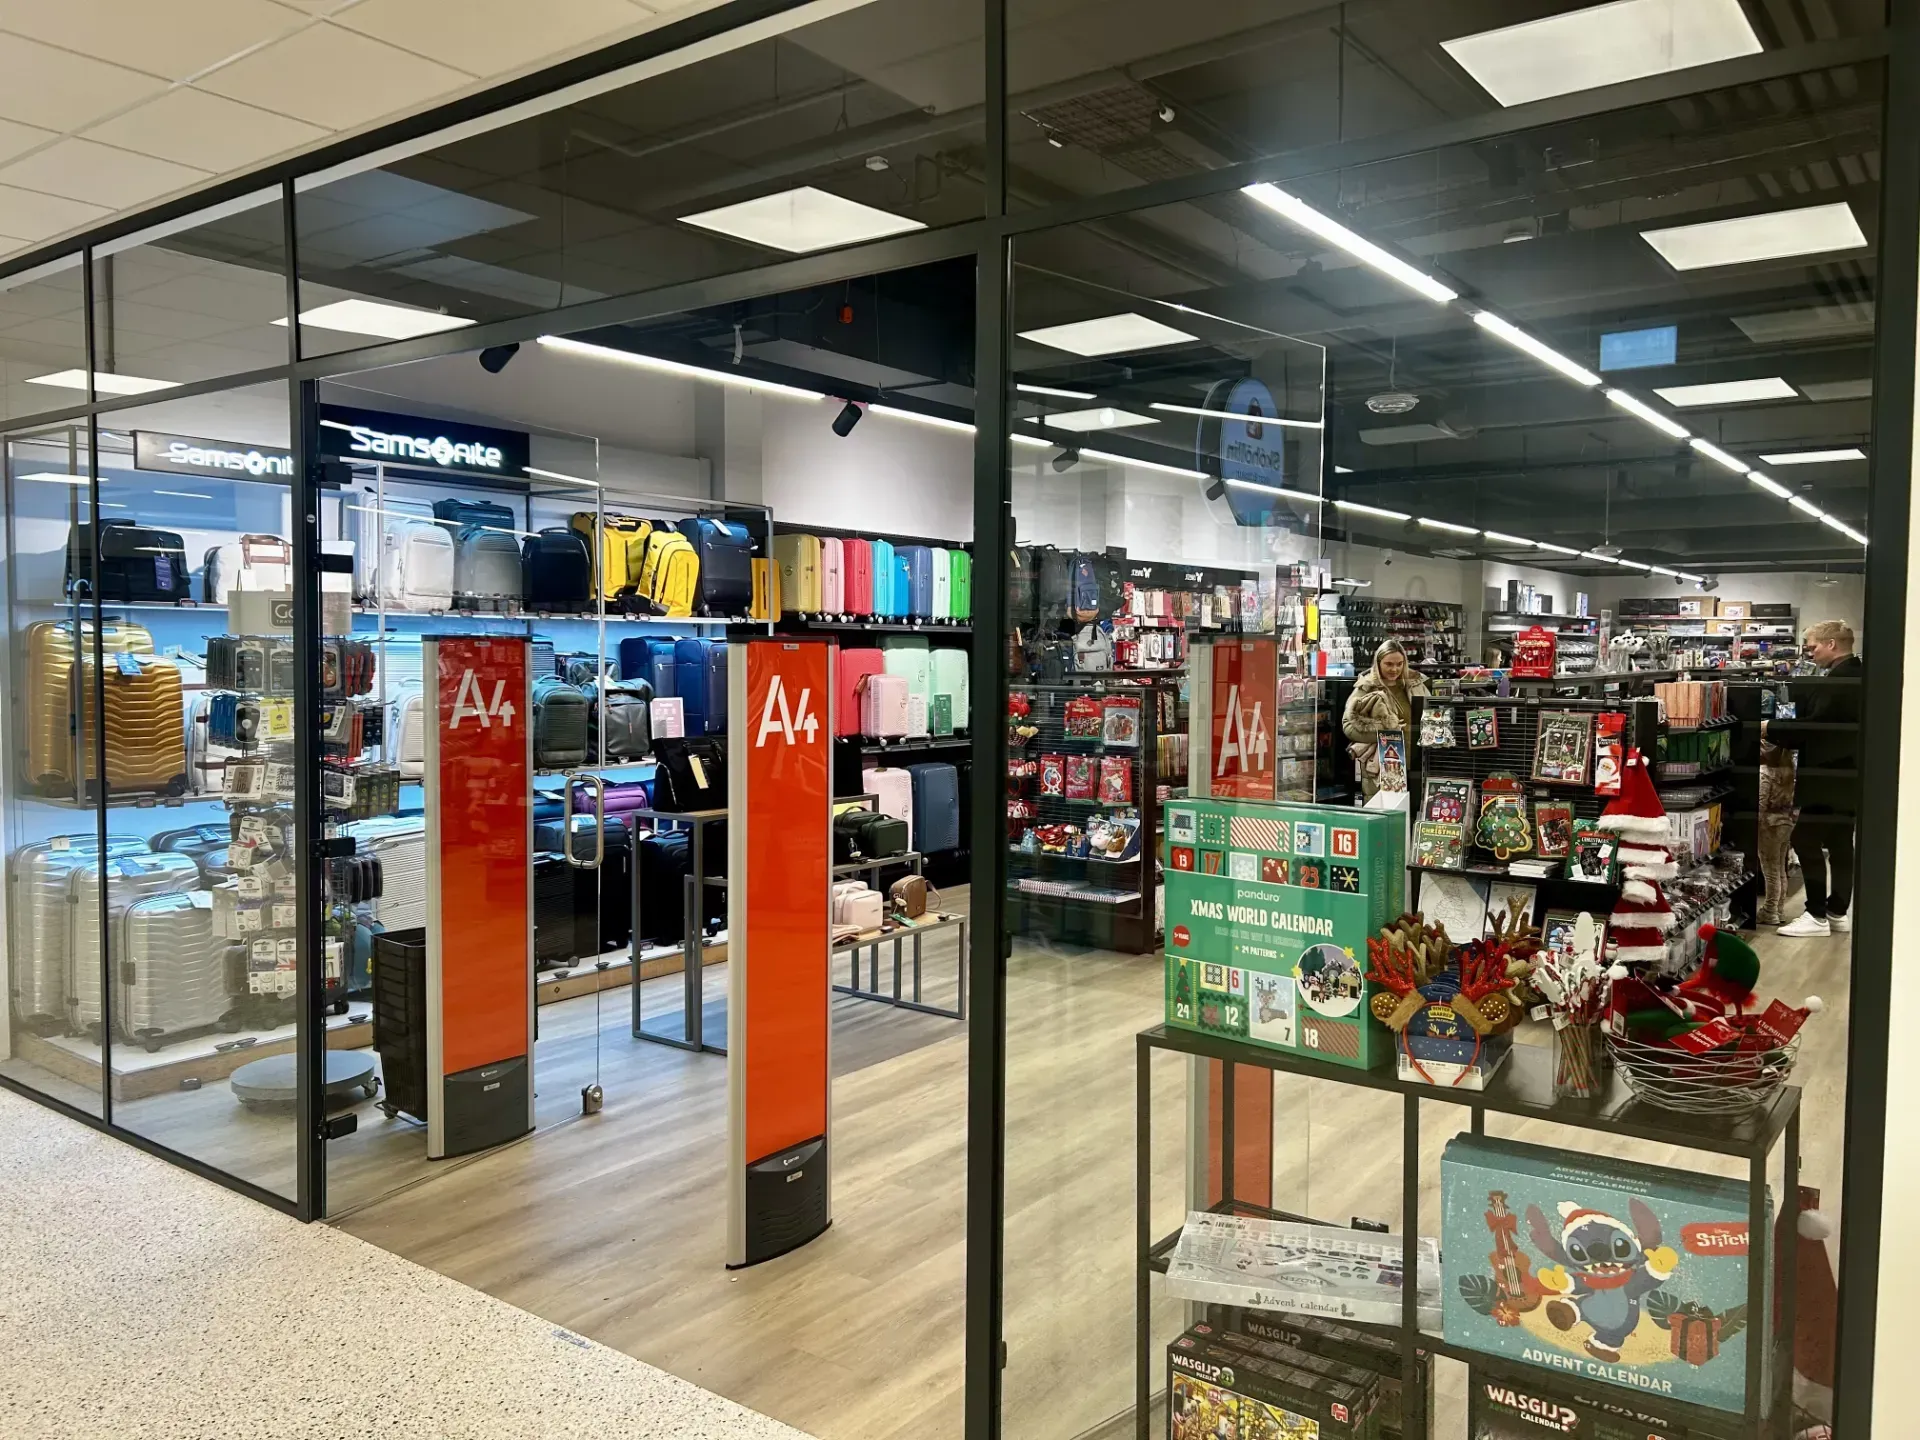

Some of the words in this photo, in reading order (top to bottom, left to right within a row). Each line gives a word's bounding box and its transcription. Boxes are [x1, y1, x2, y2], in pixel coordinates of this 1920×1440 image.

[350, 426, 501, 468] Samsonite
[168, 443, 294, 475] Samsonit
[449, 668, 516, 729] A4
[755, 675, 819, 747] A4
[1218, 684, 1268, 776] A4
[1209, 822, 1216, 836] 5
[1276, 830, 1286, 850] 8
[1338, 834, 1352, 853] 16
[1178, 854, 1188, 868] 13
[1204, 852, 1222, 875] 17
[1300, 865, 1319, 889] 23
[1237, 889, 1280, 903] panduro
[1190, 899, 1223, 920] XMAS
[1226, 904, 1267, 927] WORLD
[1271, 911, 1334, 938] CALENDAR
[1250, 946, 1277, 959] PATTERNS
[1232, 970, 1239, 988] 6
[1176, 1003, 1190, 1019] 24
[1225, 1006, 1239, 1026] 12
[1284, 1027, 1291, 1041] 7
[1304, 1028, 1318, 1048] 18
[1549, 1172, 1589, 1183] ADVENT
[1592, 1179, 1647, 1193] CALENDAR
[1555, 1166, 1594, 1177] ADVENT
[1596, 1172, 1652, 1187] CALENDAR
[1263, 1295, 1295, 1308] Advent
[1300, 1302, 1340, 1314] calendar
[1171, 1353, 1221, 1382] WASGIJ?
[1521, 1347, 1583, 1375] ADVENT
[1587, 1362, 1673, 1394] CALENDAR
[1486, 1383, 1578, 1432] WASGIJ?
[1520, 1411, 1561, 1431] CALENDAR
